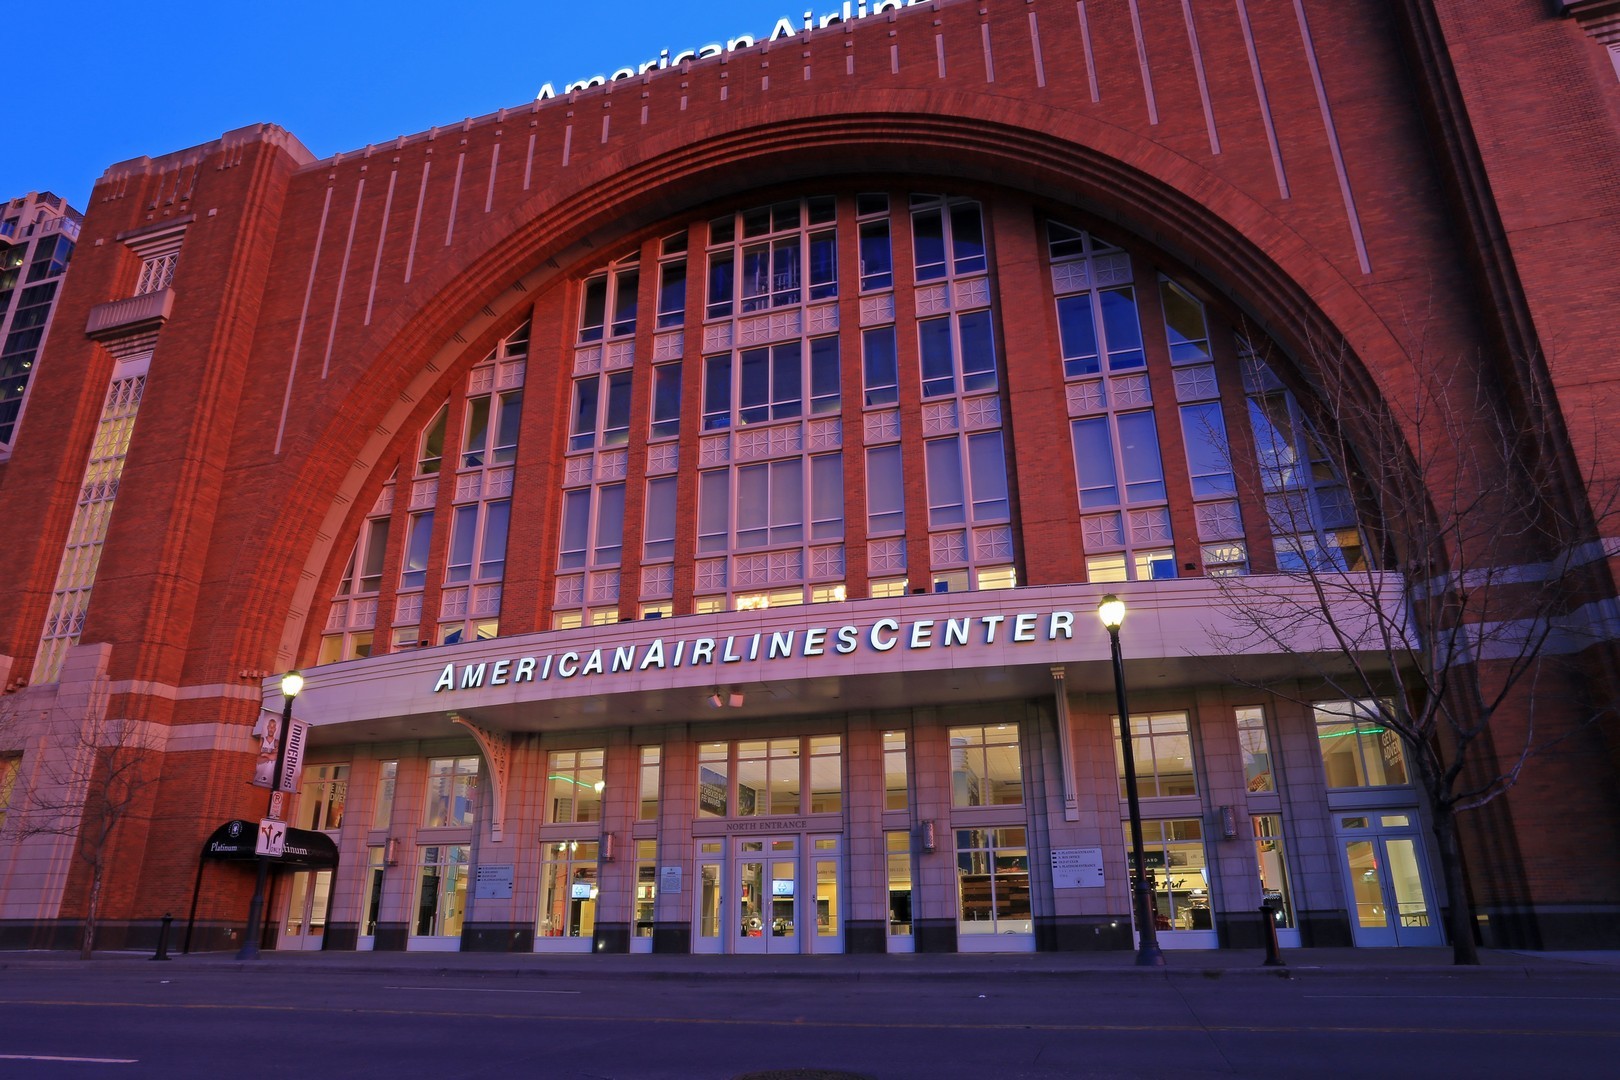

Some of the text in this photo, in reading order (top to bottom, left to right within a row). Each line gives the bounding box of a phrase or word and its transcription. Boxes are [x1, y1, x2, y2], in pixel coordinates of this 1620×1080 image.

[434, 611, 1075, 692] AMERICAN AIRLINES CENTER
[726, 821, 807, 831] NORTH ENTRANCE
